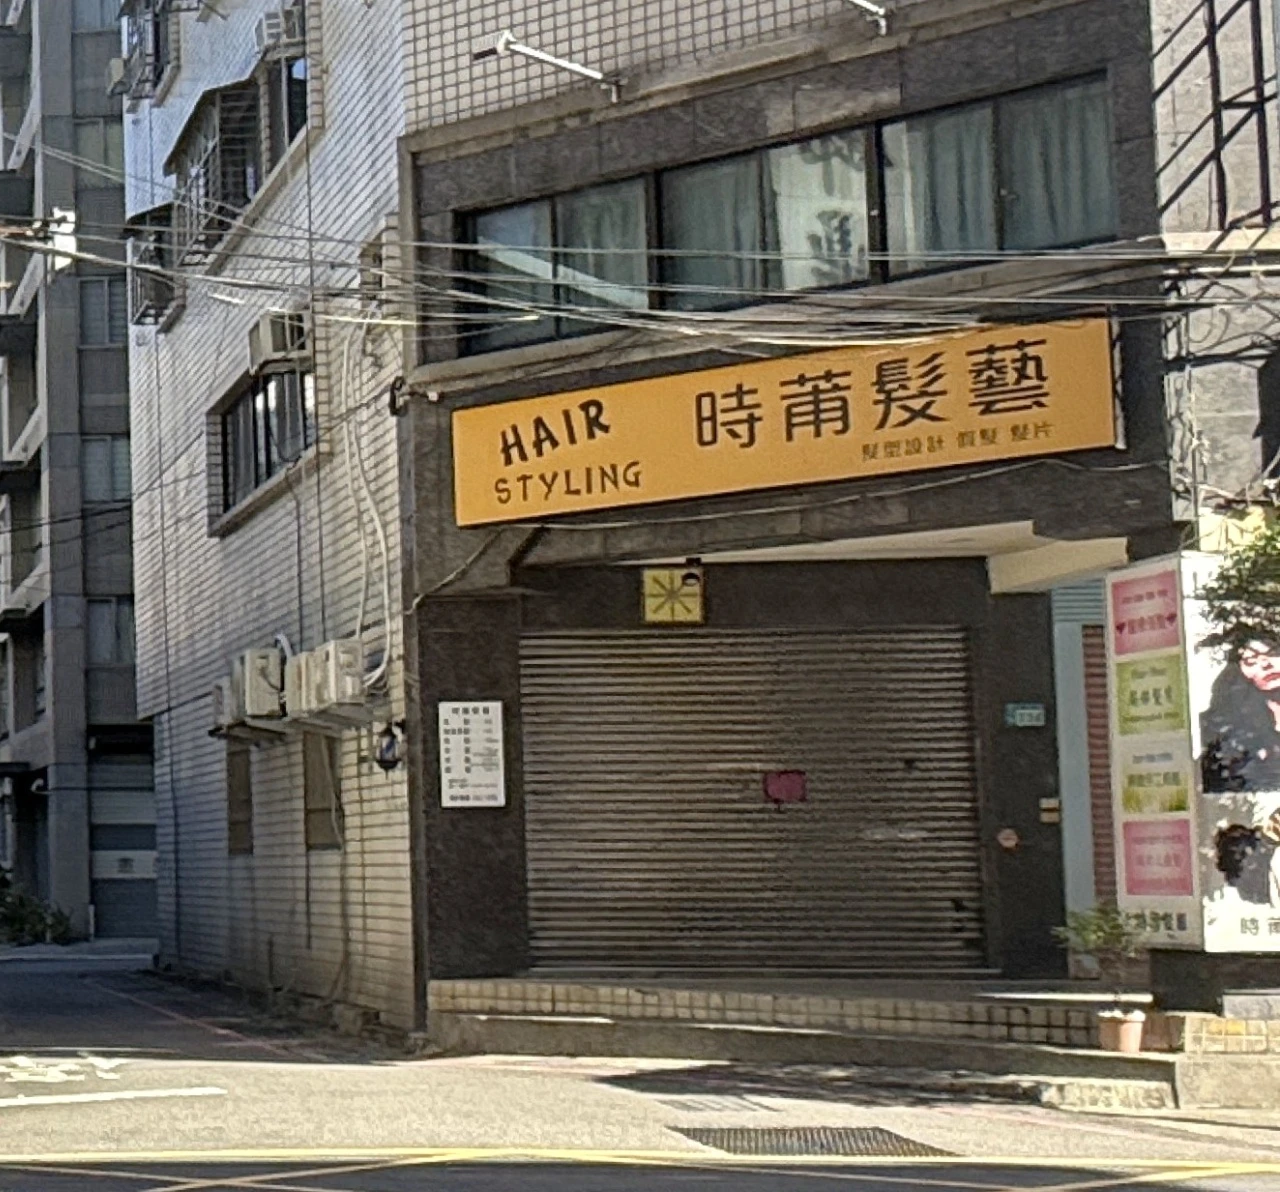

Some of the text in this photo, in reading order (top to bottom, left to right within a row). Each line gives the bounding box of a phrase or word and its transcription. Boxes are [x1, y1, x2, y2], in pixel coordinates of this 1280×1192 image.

[693, 336, 1049, 450] 時莆髮藝
[499, 398, 612, 467] HAIR
[493, 459, 644, 506] STYLING
